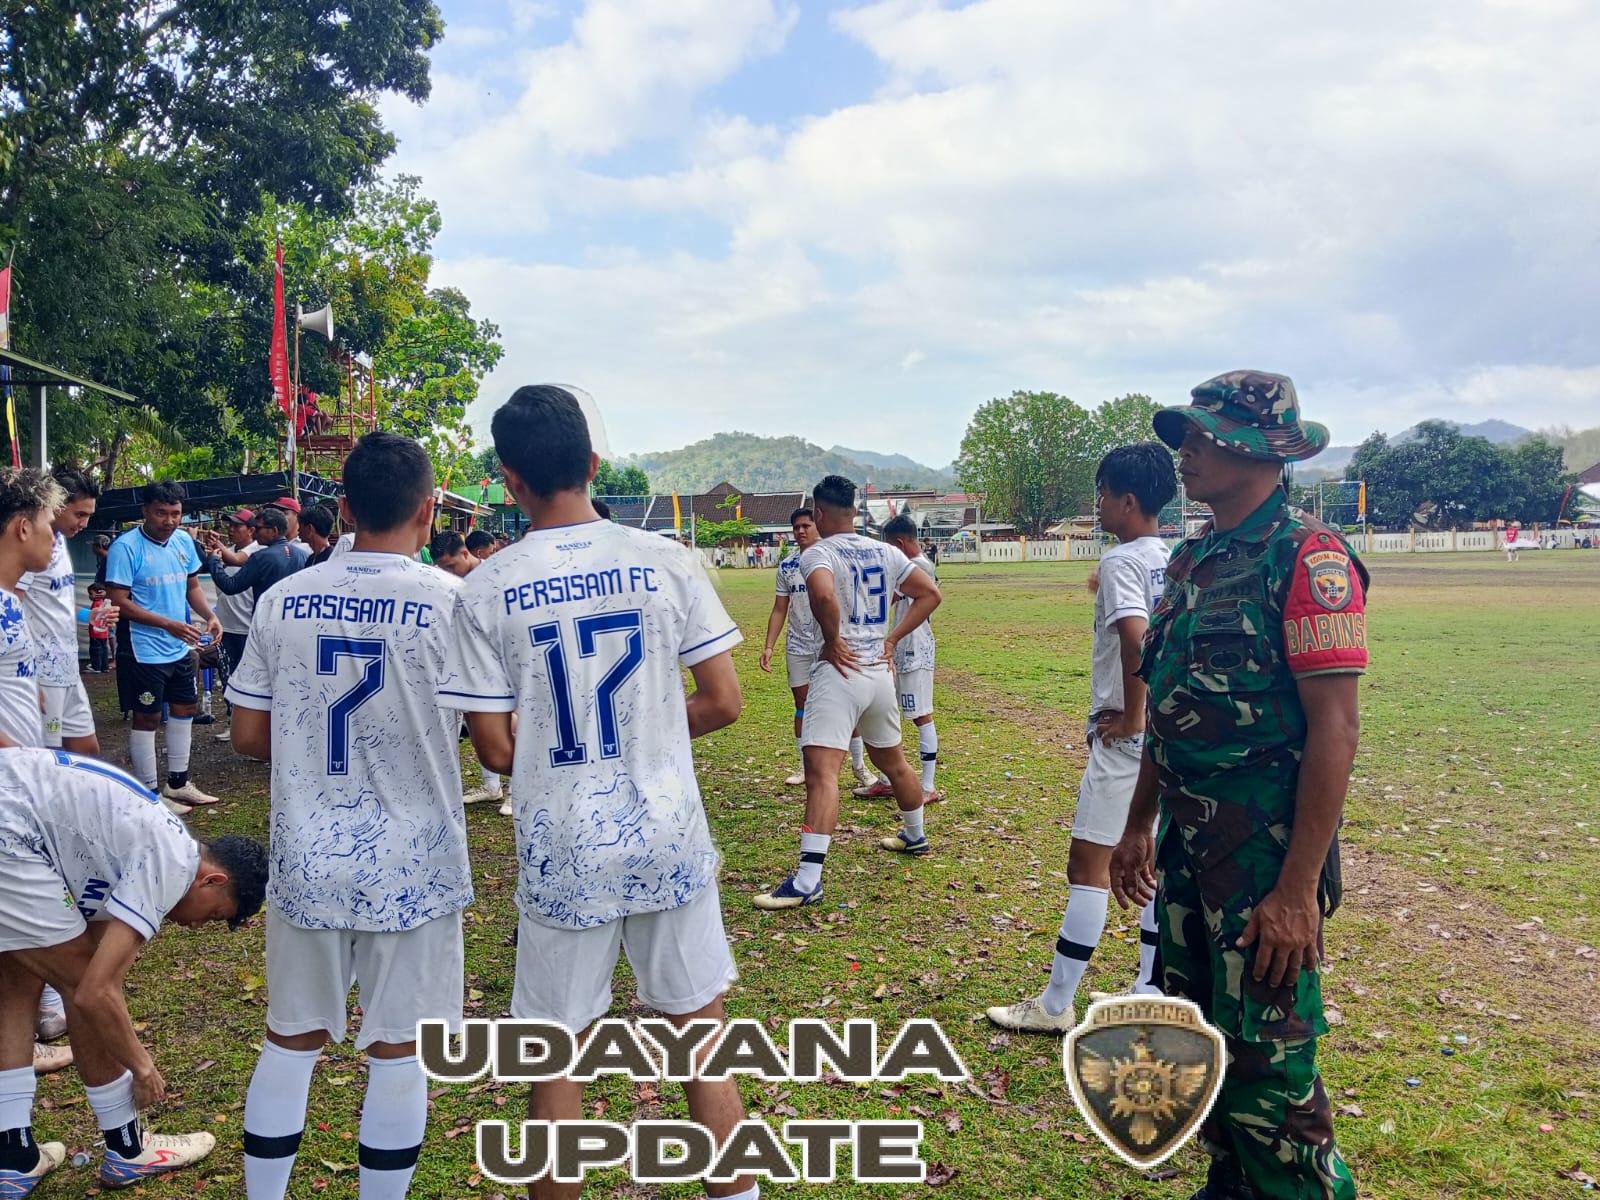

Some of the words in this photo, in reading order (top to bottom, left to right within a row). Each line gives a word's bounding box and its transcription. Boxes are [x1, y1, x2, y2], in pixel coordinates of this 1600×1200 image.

[281, 594, 395, 624] PERSISAM
[400, 601, 432, 628] FC
[503, 568, 622, 615] PERSISAM
[628, 567, 658, 593] FC
[848, 563, 888, 625] 13
[1283, 612, 1367, 656] BABINS
[316, 634, 386, 775] 7
[528, 608, 645, 768] 17
[901, 694, 916, 708] 08
